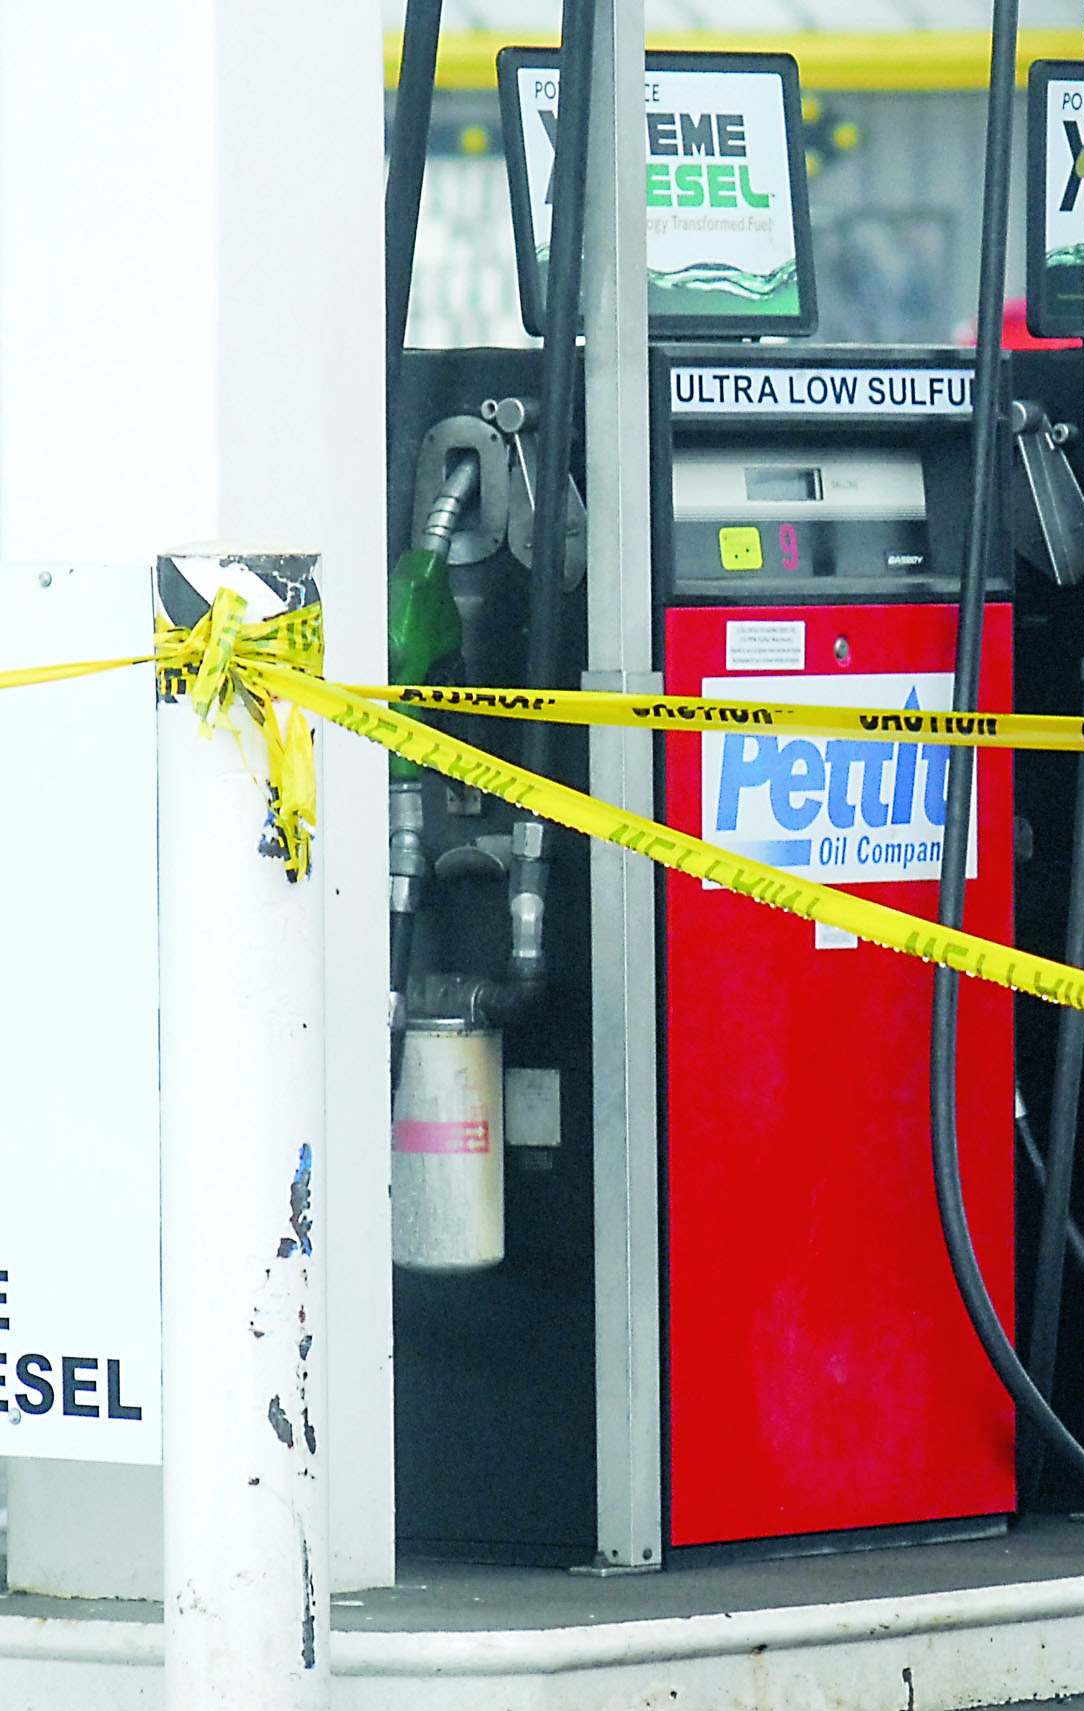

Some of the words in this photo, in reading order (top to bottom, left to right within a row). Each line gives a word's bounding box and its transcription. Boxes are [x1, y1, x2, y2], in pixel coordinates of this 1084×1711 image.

[645, 164, 770, 208] ESEL
[675, 374, 779, 404] ULTRA
[789, 376, 858, 405] LOW
[779, 523, 798, 570] 9
[716, 685, 951, 832] Pettit
[819, 837, 847, 866] Oil
[856, 835, 941, 869] Compan
[0, 1352, 143, 1421] SEL
